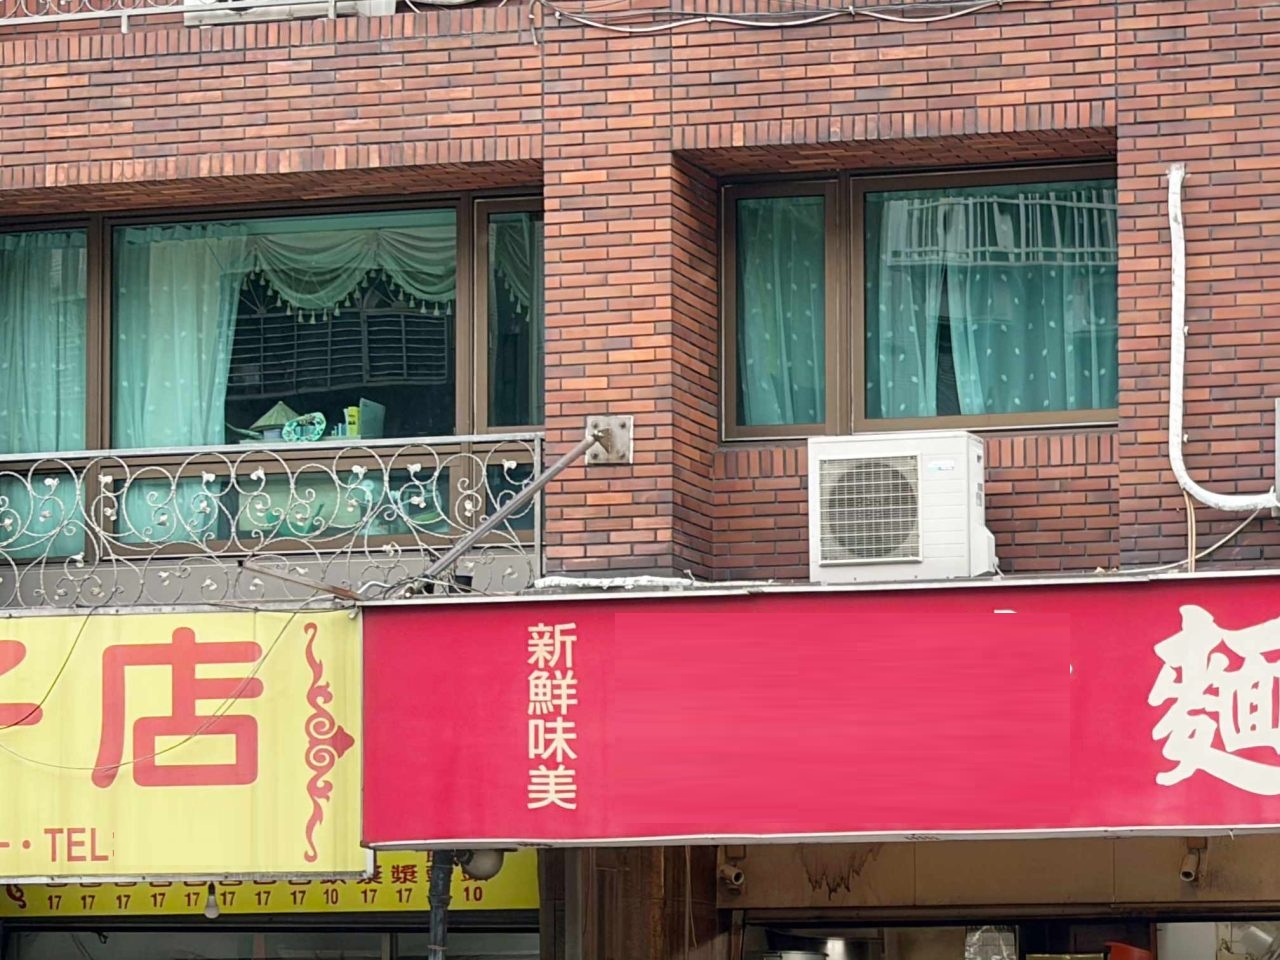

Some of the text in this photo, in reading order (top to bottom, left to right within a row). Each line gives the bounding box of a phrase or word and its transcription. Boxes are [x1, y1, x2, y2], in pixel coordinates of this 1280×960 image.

[0, 627, 264, 788] 店
[527, 622, 578, 810] 新鮮味美
[48, 886, 483, 910] 17 17 17 17 17 17 17 17 10 17 17 10
